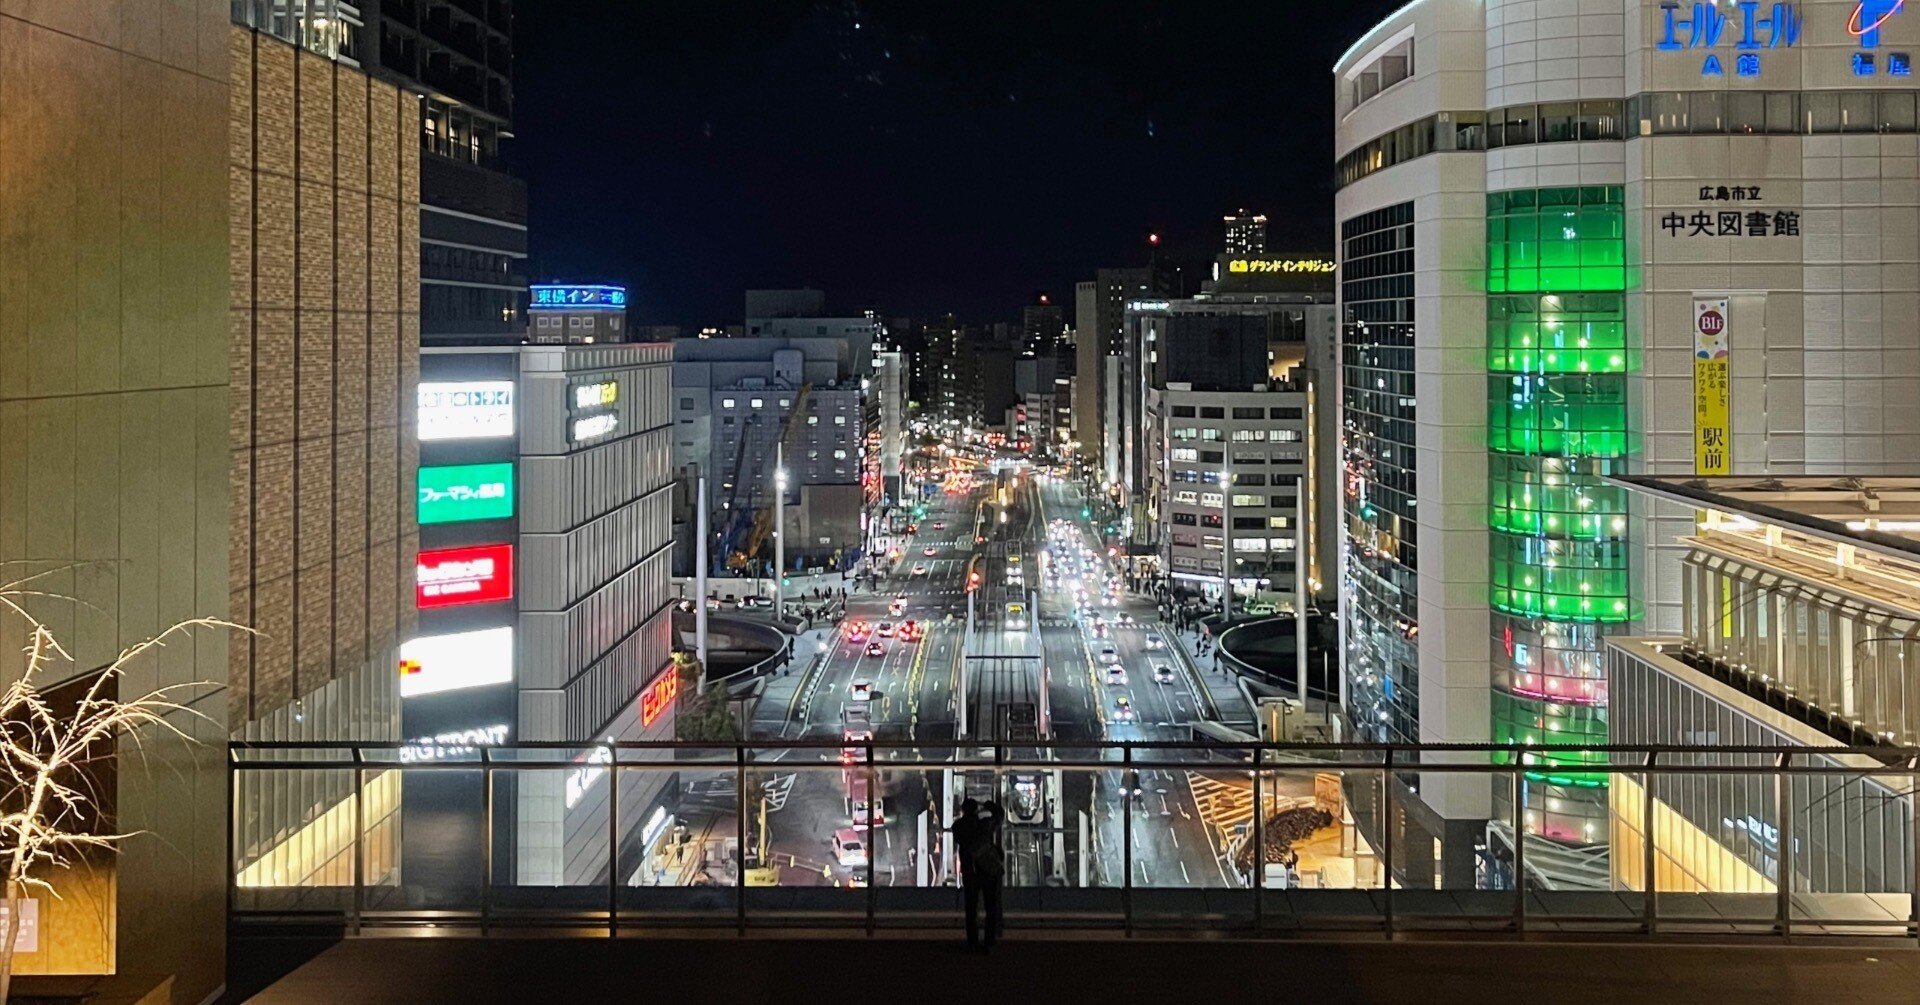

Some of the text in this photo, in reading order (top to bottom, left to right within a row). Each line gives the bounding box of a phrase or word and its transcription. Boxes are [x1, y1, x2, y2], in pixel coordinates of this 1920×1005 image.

[1699, 186, 1762, 201] 広島市立
[1661, 210, 1800, 237] 中央図書館
[1702, 426, 1723, 469] 駅前
